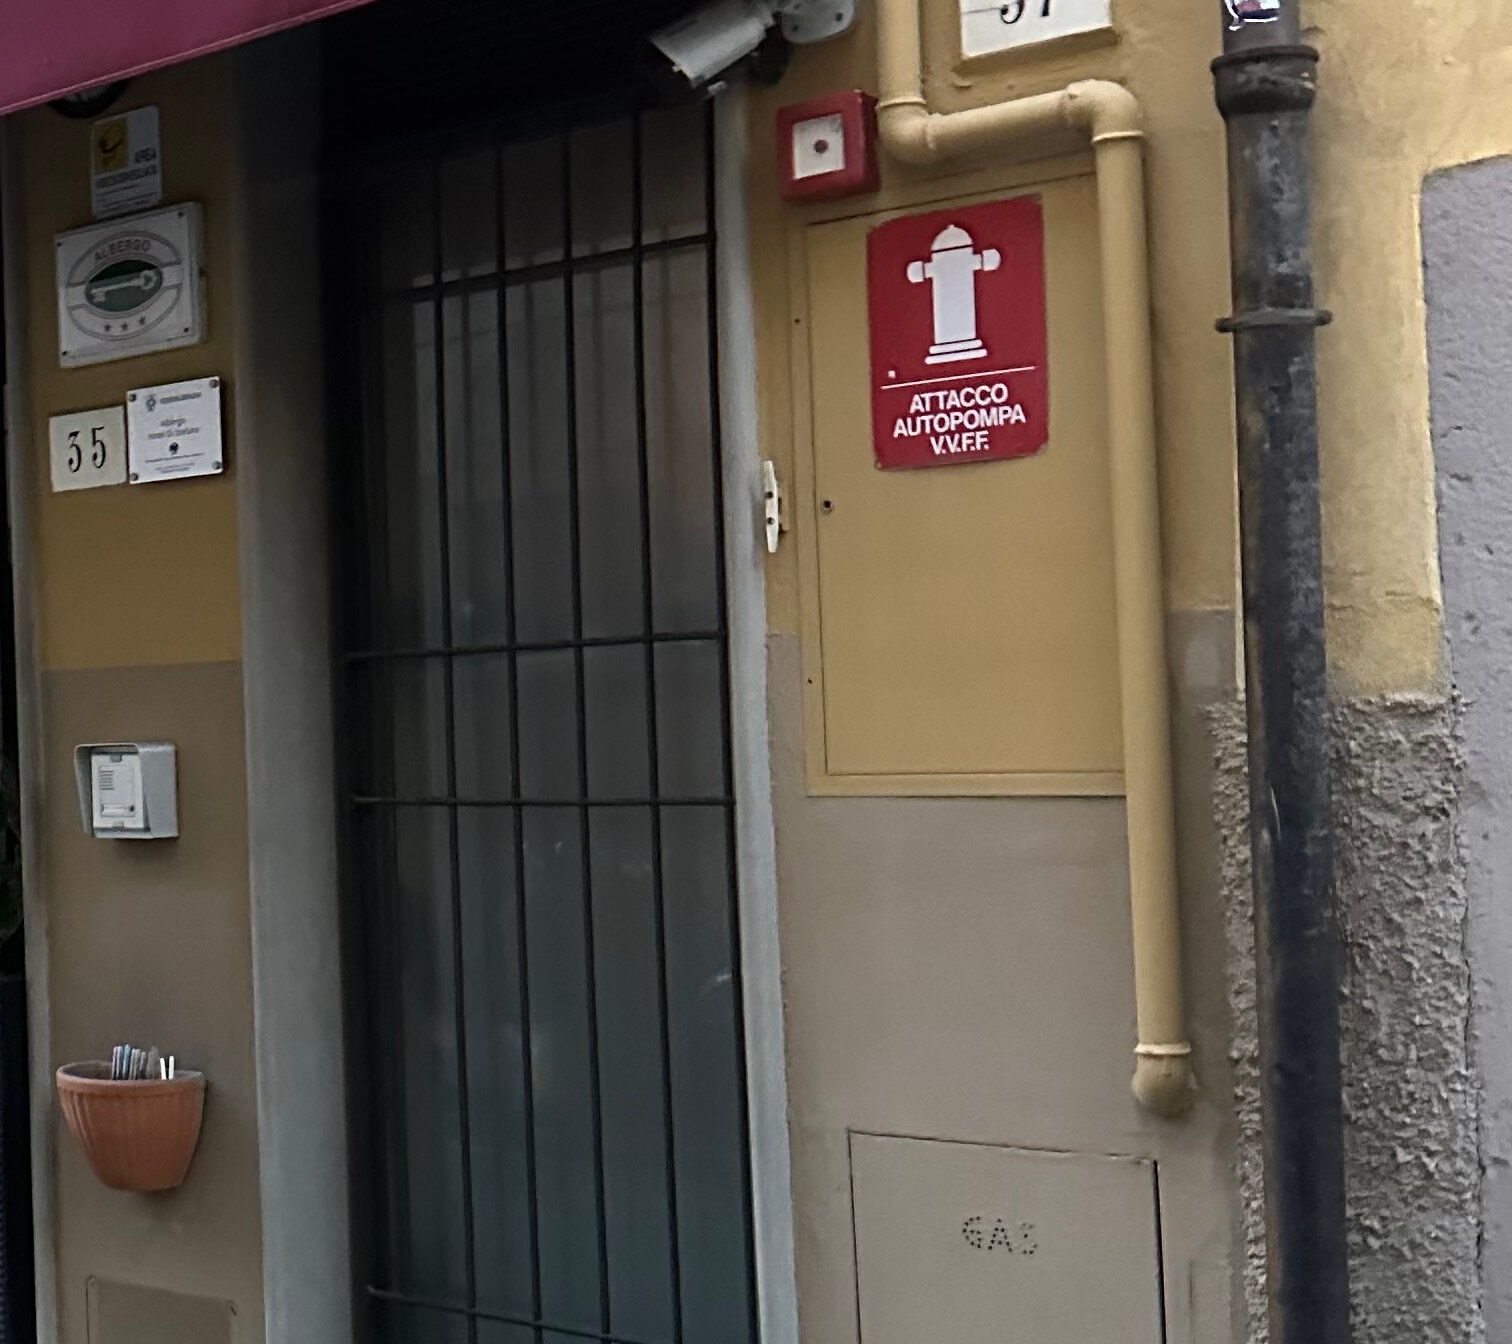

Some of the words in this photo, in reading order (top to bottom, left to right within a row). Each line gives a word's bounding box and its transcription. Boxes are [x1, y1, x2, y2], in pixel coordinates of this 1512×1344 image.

[94, 238, 151, 261] ALBERGO
[909, 382, 1009, 414] ATTACCO
[893, 403, 1027, 439] AUTOPOMPA
[67, 425, 107, 473] 35
[929, 430, 990, 455] V.V.F.F.
[962, 1215, 1039, 1255] GAS
